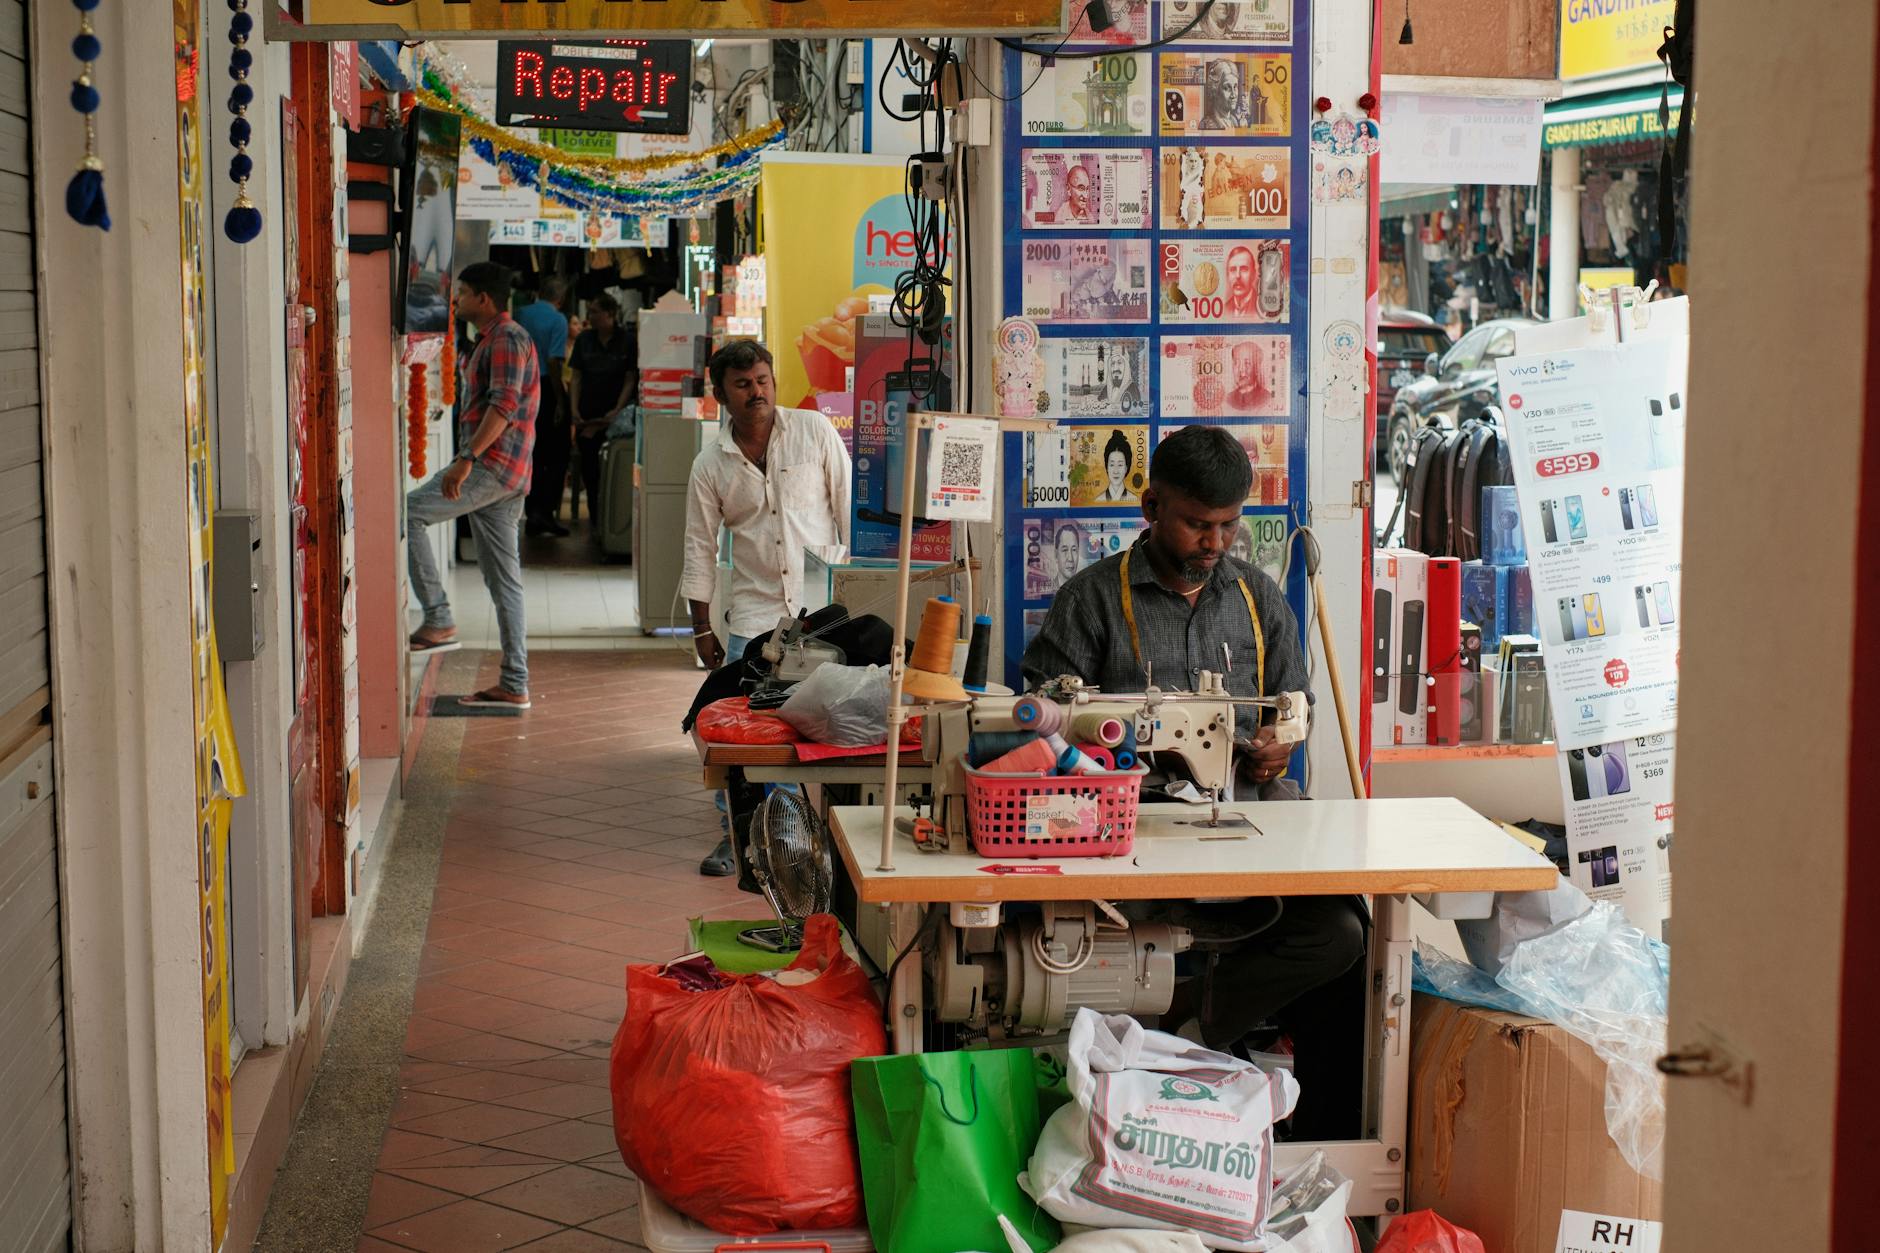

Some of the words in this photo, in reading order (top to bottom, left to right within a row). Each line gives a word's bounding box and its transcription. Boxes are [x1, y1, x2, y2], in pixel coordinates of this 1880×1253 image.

[552, 46, 592, 57] MOBILE
[597, 48, 637, 59] PHONE
[1100, 56, 1137, 82] 100
[1264, 61, 1287, 84] 50
[515, 49, 678, 111] Repair
[1028, 120, 1045, 132] 100
[1163, 153, 1176, 166] 100
[1249, 188, 1282, 214] 100
[1026, 244, 1061, 261] 2000
[865, 260, 876, 268] by
[1165, 244, 1179, 278] 100
[1191, 297, 1223, 319] 100
[1198, 361, 1223, 375] 100
[1509, 366, 1538, 376] vivo
[860, 400, 898, 426] BIG
[1523, 410, 1542, 419] V30
[859, 425, 903, 435] COLORFUL
[1136, 429, 1145, 469] 50000
[1543, 453, 1592, 475] $599
[1032, 487, 1069, 502] 50000
[1255, 519, 1285, 544] 100
[1028, 526, 1040, 566] 100
[1540, 550, 1561, 559] V29e
[1592, 575, 1611, 584] $499
[1635, 737, 1646, 748] 12
[1651, 735, 1663, 744] 5G
[1643, 768, 1664, 779] $369
[1028, 811, 1061, 820] Basket
[1591, 1219, 1634, 1247] RH
